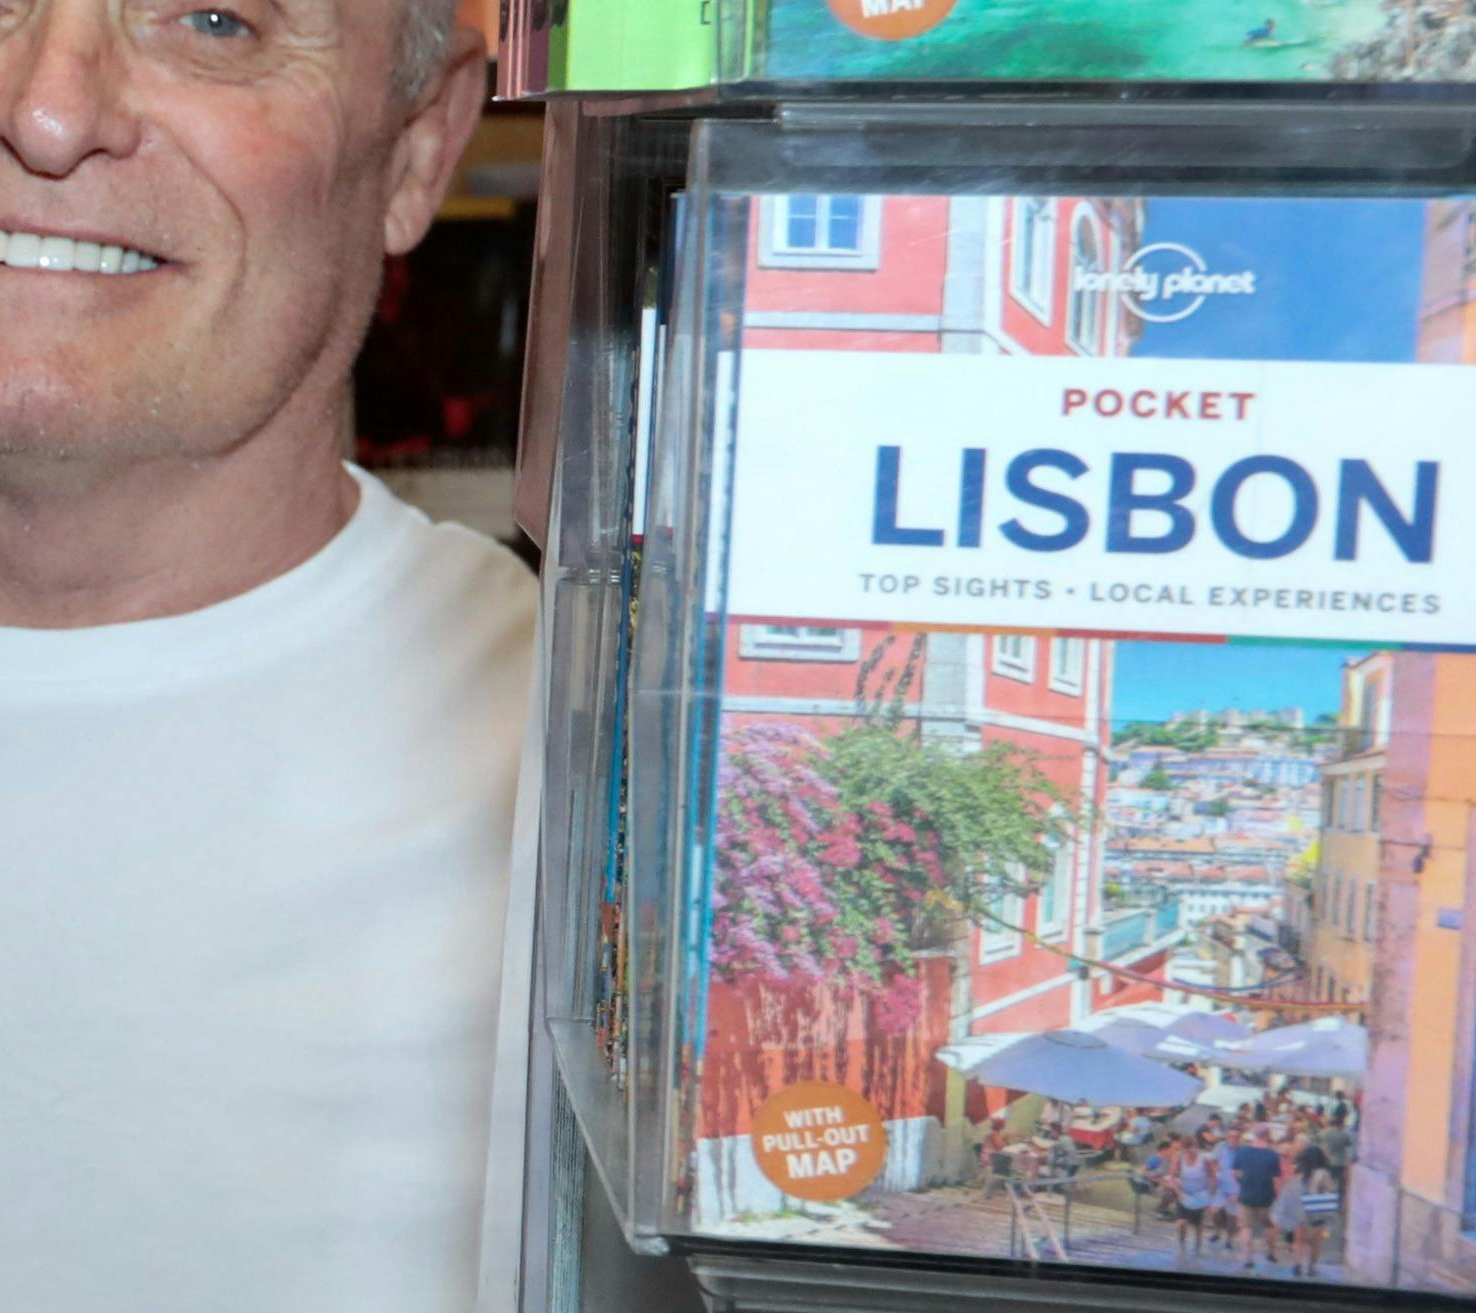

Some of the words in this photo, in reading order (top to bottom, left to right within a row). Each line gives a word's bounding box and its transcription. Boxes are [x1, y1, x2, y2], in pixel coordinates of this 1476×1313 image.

[1073, 264, 1157, 301] lonely
[1161, 265, 1257, 305] planet
[1061, 387, 1258, 422] POCKET
[870, 443, 1443, 567] LISBON
[859, 572, 922, 596] TOP
[932, 573, 1054, 602] SIGHTS
[1088, 579, 1194, 608] LOCAL
[1205, 585, 1443, 616] EXPERIENCES
[784, 1104, 844, 1131] WITH
[762, 1122, 870, 1158] PULL-OUT
[785, 1145, 858, 1180] MAP
